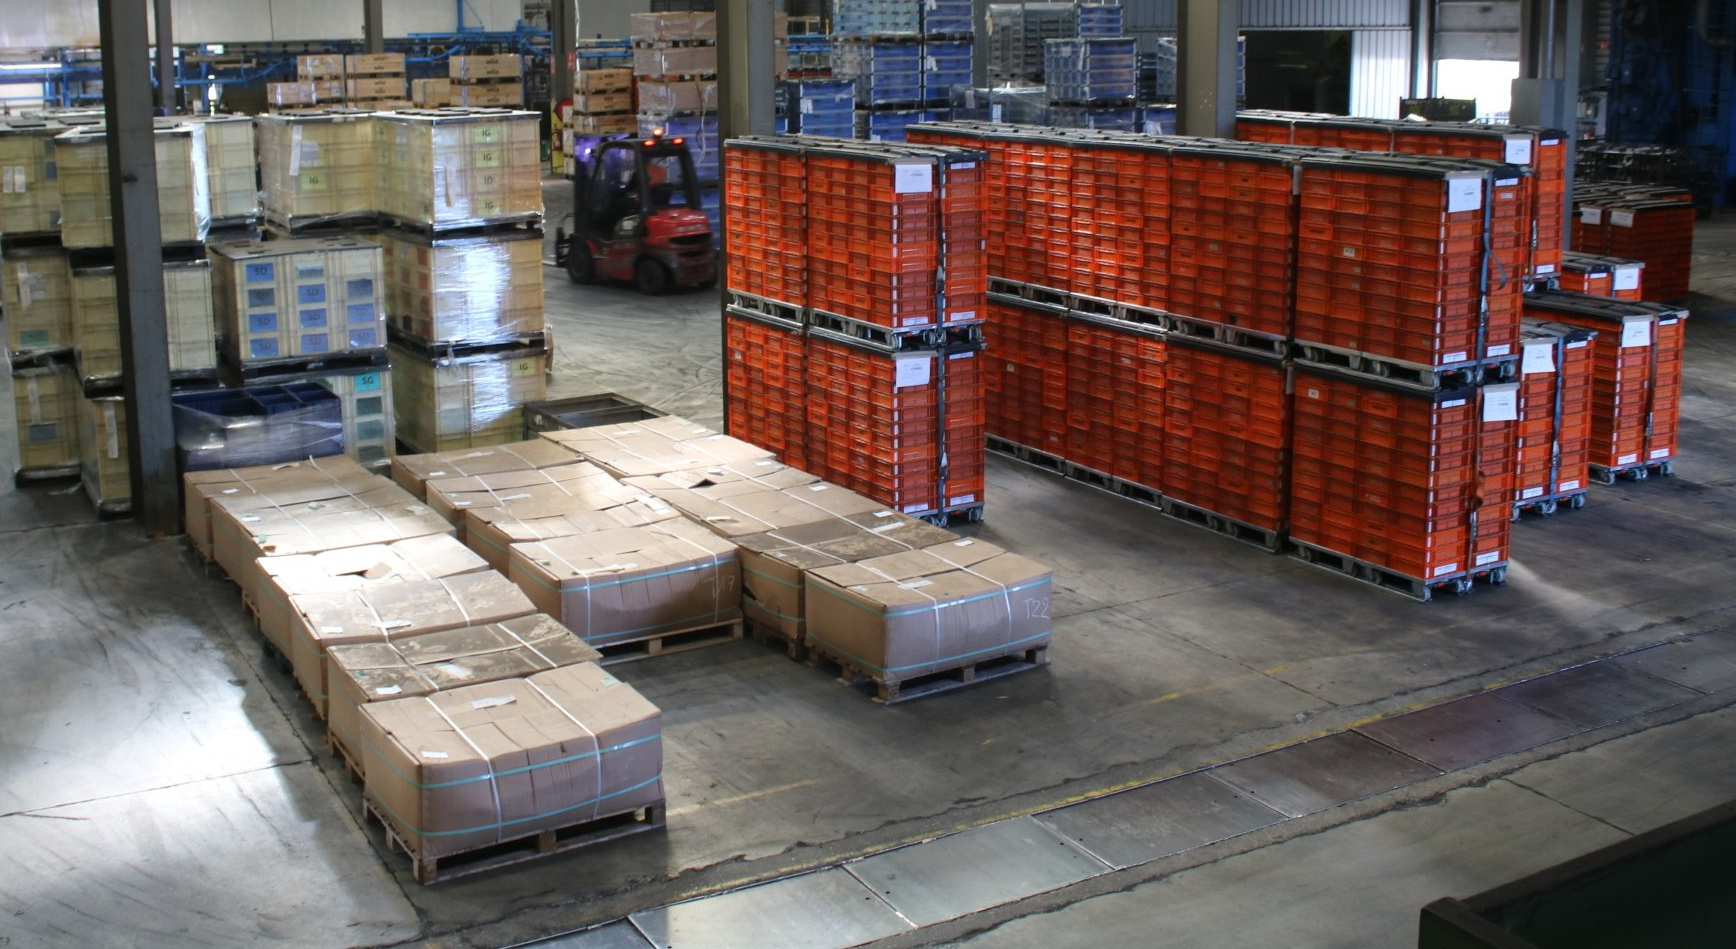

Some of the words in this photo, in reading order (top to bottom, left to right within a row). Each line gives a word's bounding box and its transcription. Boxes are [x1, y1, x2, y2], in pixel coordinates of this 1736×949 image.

[482, 129, 491, 137] IG
[483, 153, 492, 161] IG
[485, 201, 494, 209] IG
[254, 267, 267, 276] SD
[519, 362, 528, 370] IG
[361, 376, 374, 385] SG
[1024, 596, 1050, 620] T22
